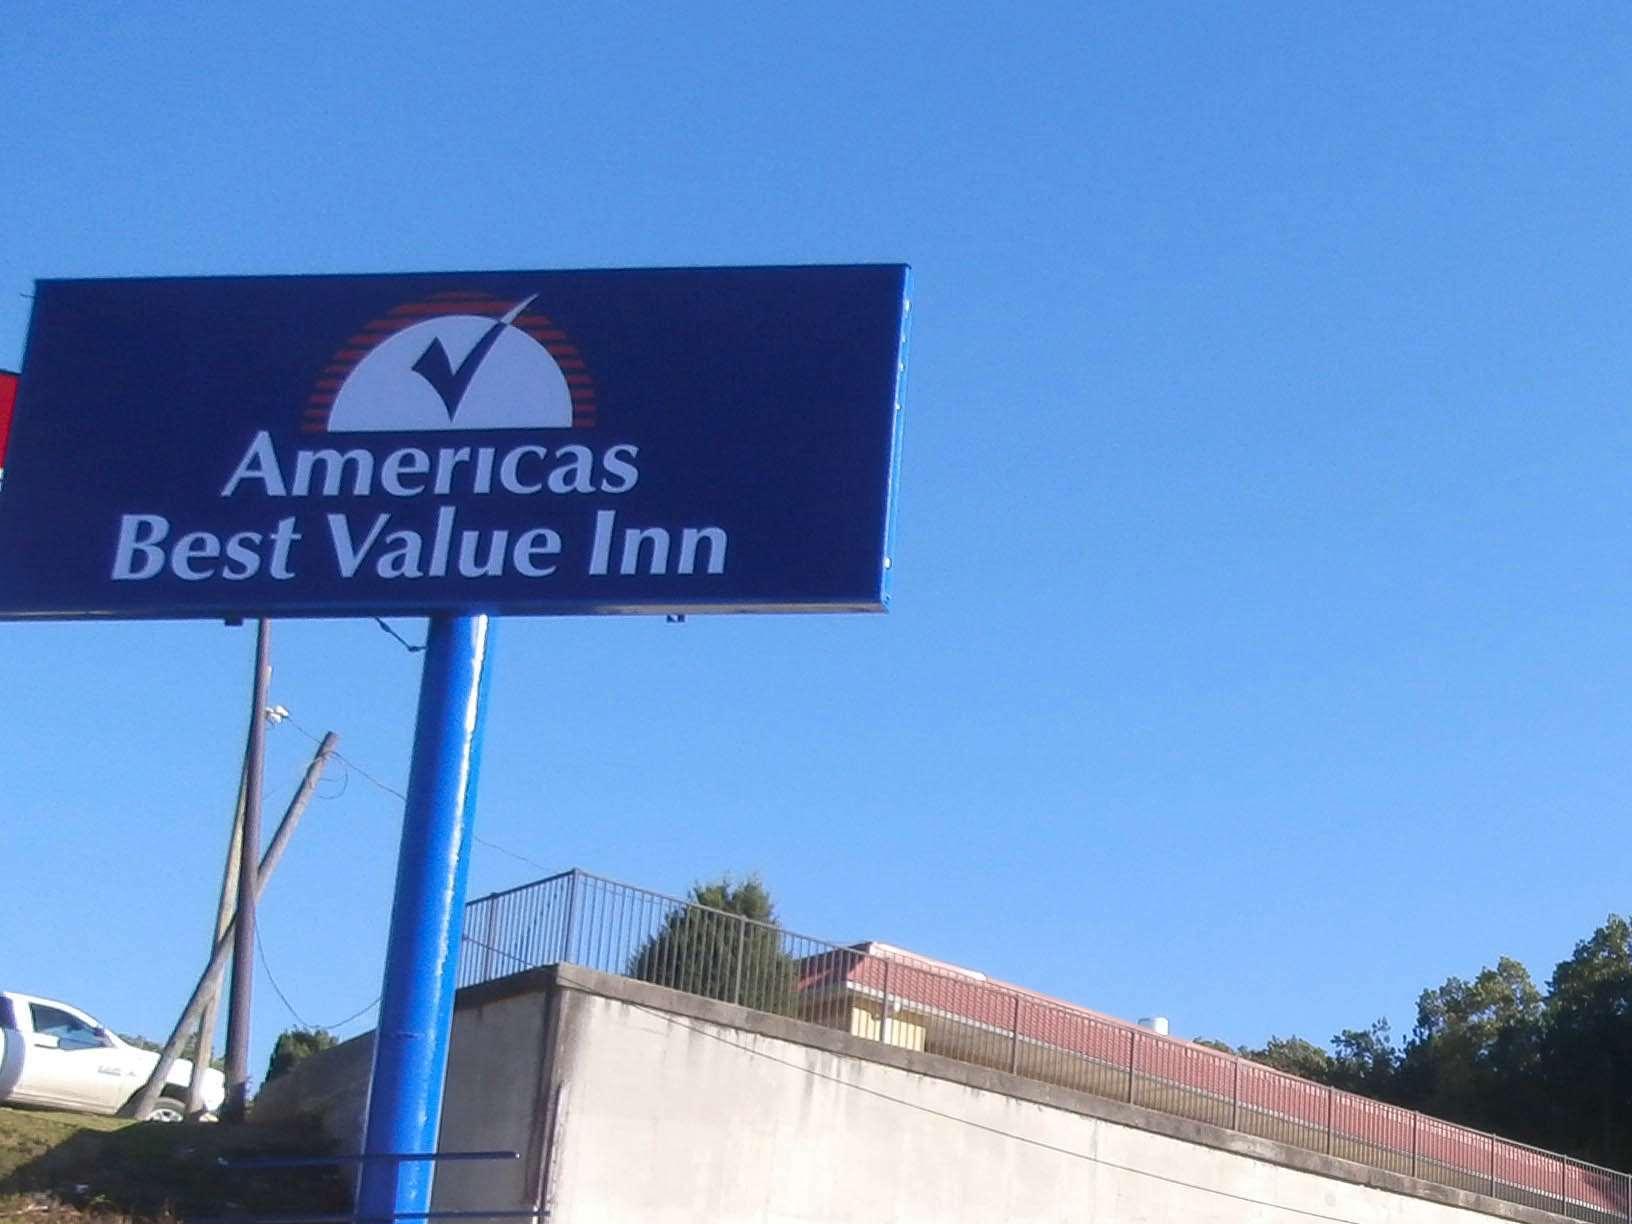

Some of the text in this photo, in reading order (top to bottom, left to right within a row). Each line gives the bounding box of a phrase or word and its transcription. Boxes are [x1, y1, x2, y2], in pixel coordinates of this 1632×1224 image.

[222, 430, 640, 498] Americas
[111, 505, 728, 581] Best Value Inn
